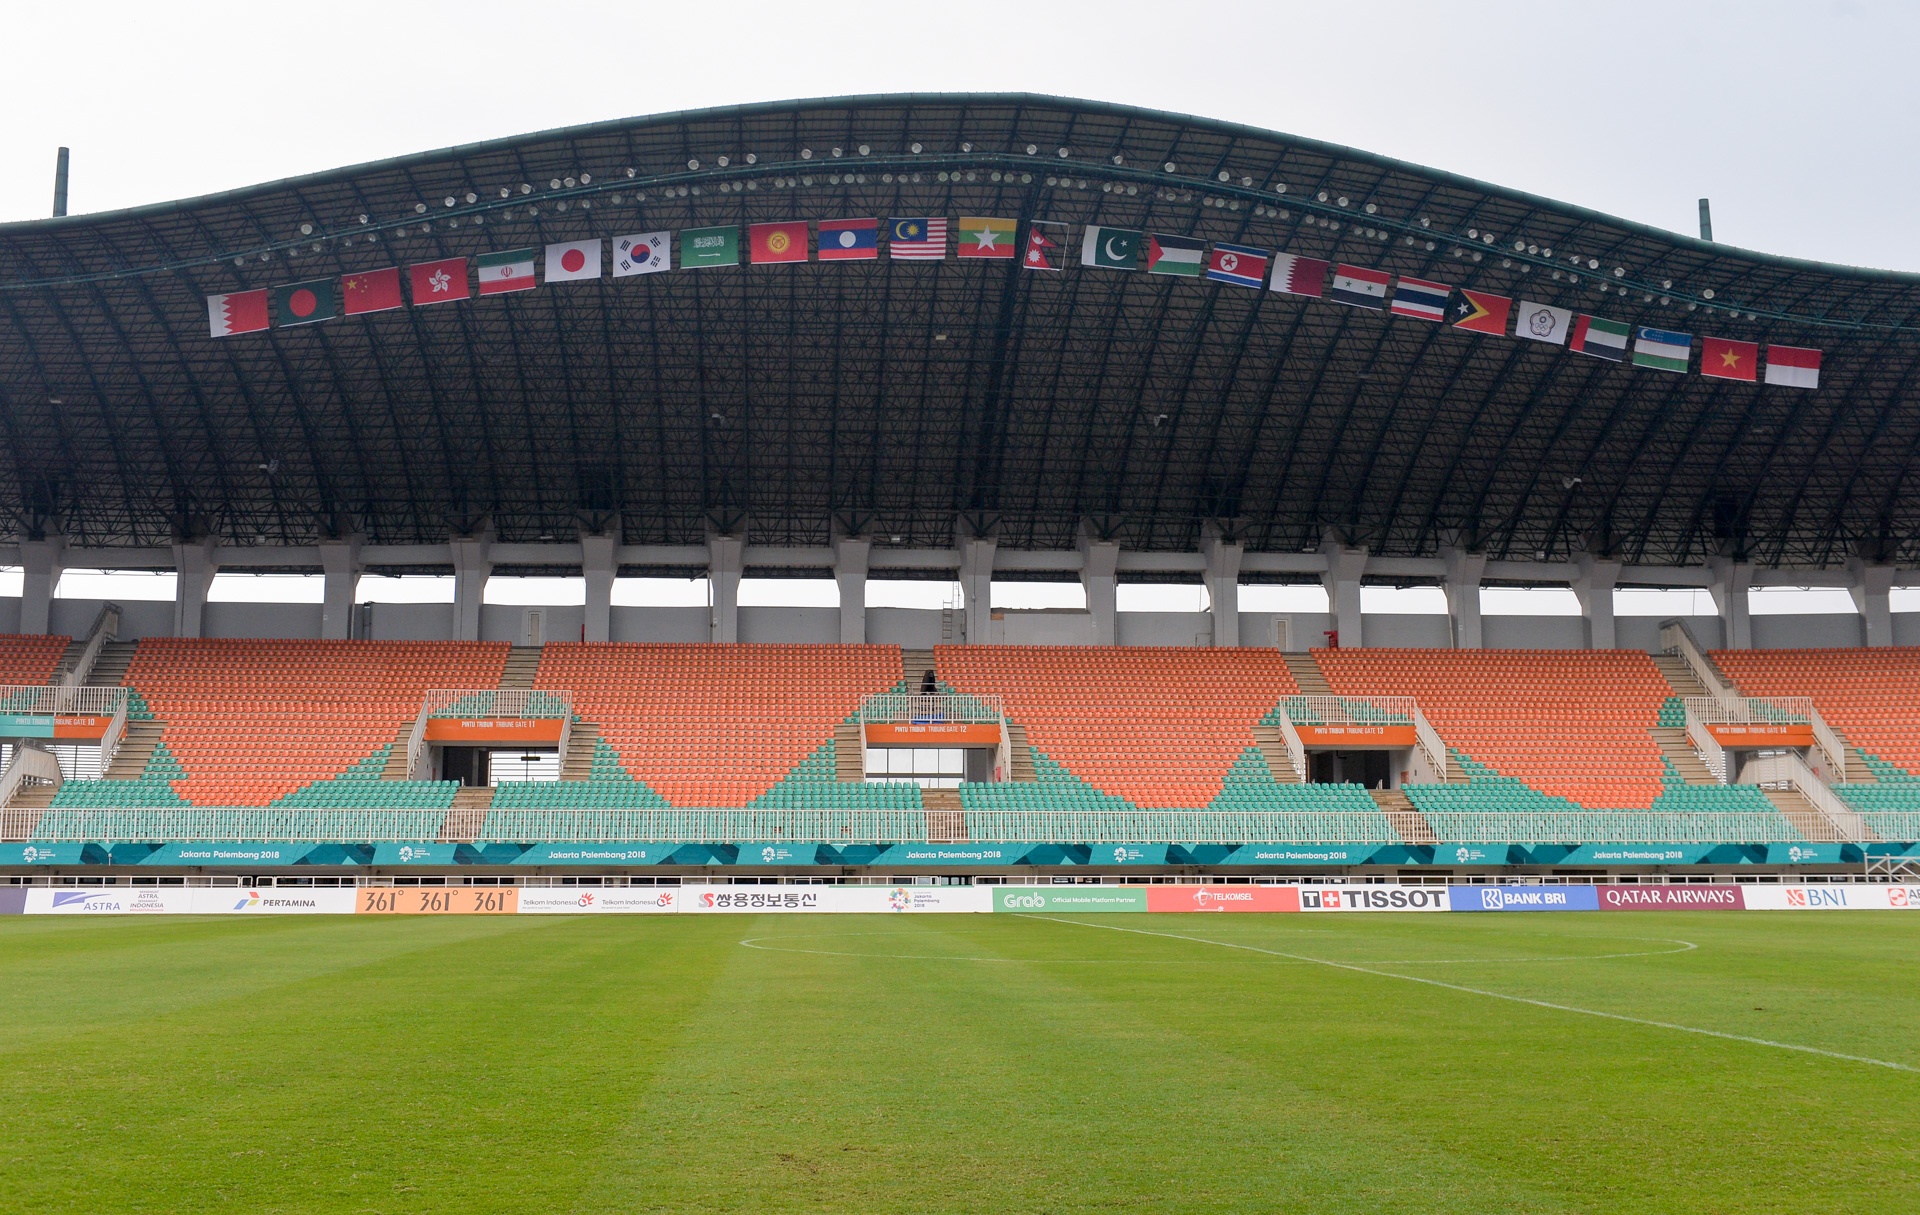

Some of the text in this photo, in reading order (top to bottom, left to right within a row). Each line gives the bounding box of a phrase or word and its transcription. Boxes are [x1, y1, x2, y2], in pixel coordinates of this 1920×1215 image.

[73, 718, 86, 726] GATE
[87, 718, 95, 726] 10
[1364, 727, 1376, 735] GATE
[1377, 727, 1384, 735] 13
[213, 851, 259, 860] Palembang
[581, 851, 626, 860] Palembang
[906, 851, 1002, 861] Jakarta Palembang 2018
[1286, 852, 1329, 861] Palembang
[1592, 851, 1683, 861] Jakarta Palembang 2018
[716, 892, 817, 909] 쌍용정보통신
[1003, 892, 1046, 908] Grab
[1213, 892, 1254, 901] TELKOMSEL
[1342, 890, 1446, 908] TISSOT
[1503, 892, 1567, 905] BANK BRI
[1606, 890, 1736, 906] QATAR AIRWAYS
[1807, 888, 1848, 906] BNI
[83, 902, 121, 911] ASTRA
[262, 899, 316, 907] PERTAMINA
